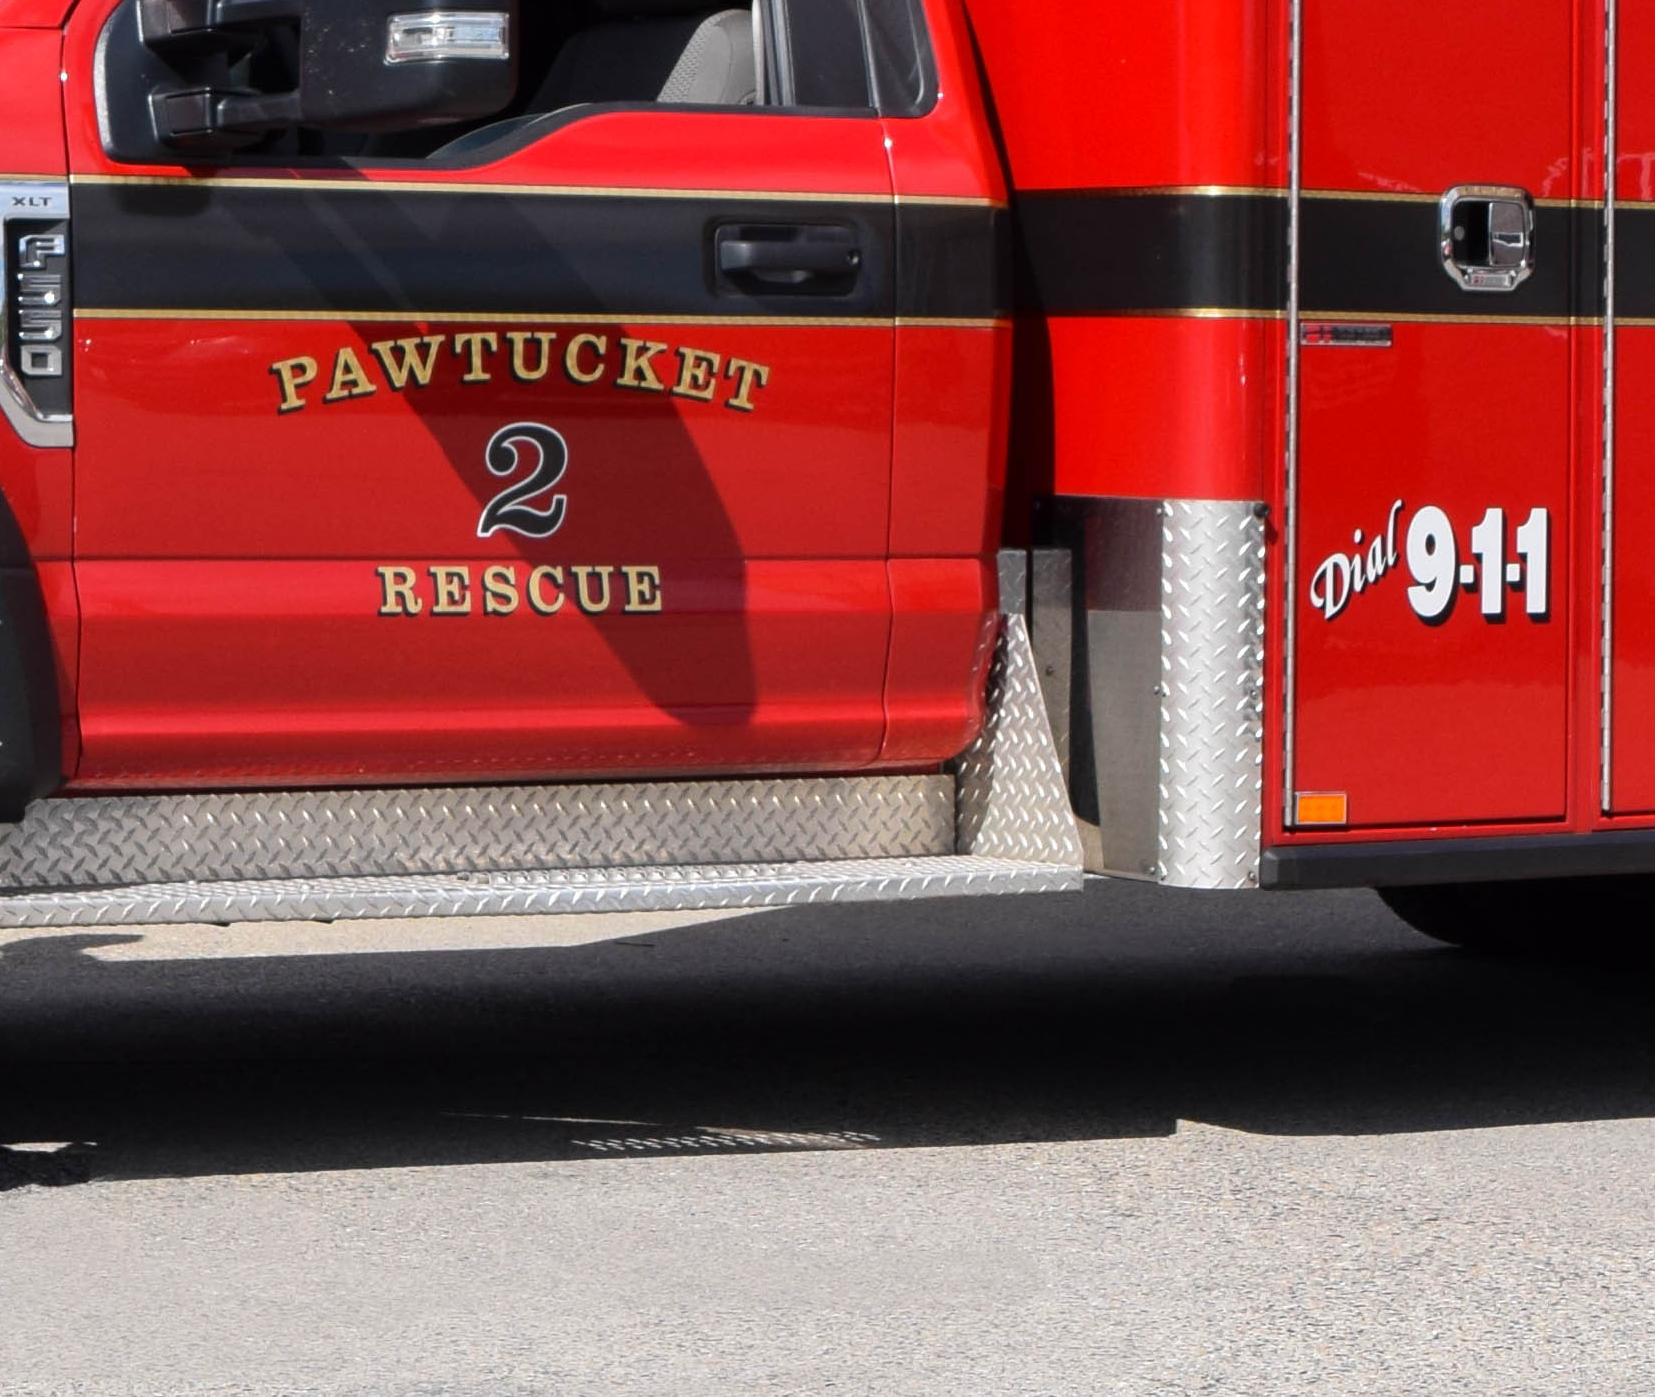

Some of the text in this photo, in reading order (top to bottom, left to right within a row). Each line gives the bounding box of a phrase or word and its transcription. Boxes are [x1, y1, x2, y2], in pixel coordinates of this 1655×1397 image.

[11, 196, 53, 207] XLT
[271, 330, 772, 415] PAWTUCKET
[477, 421, 569, 539] 2
[377, 564, 664, 617] RESCUE
[1309, 499, 1553, 626] Dial 9-1-1
